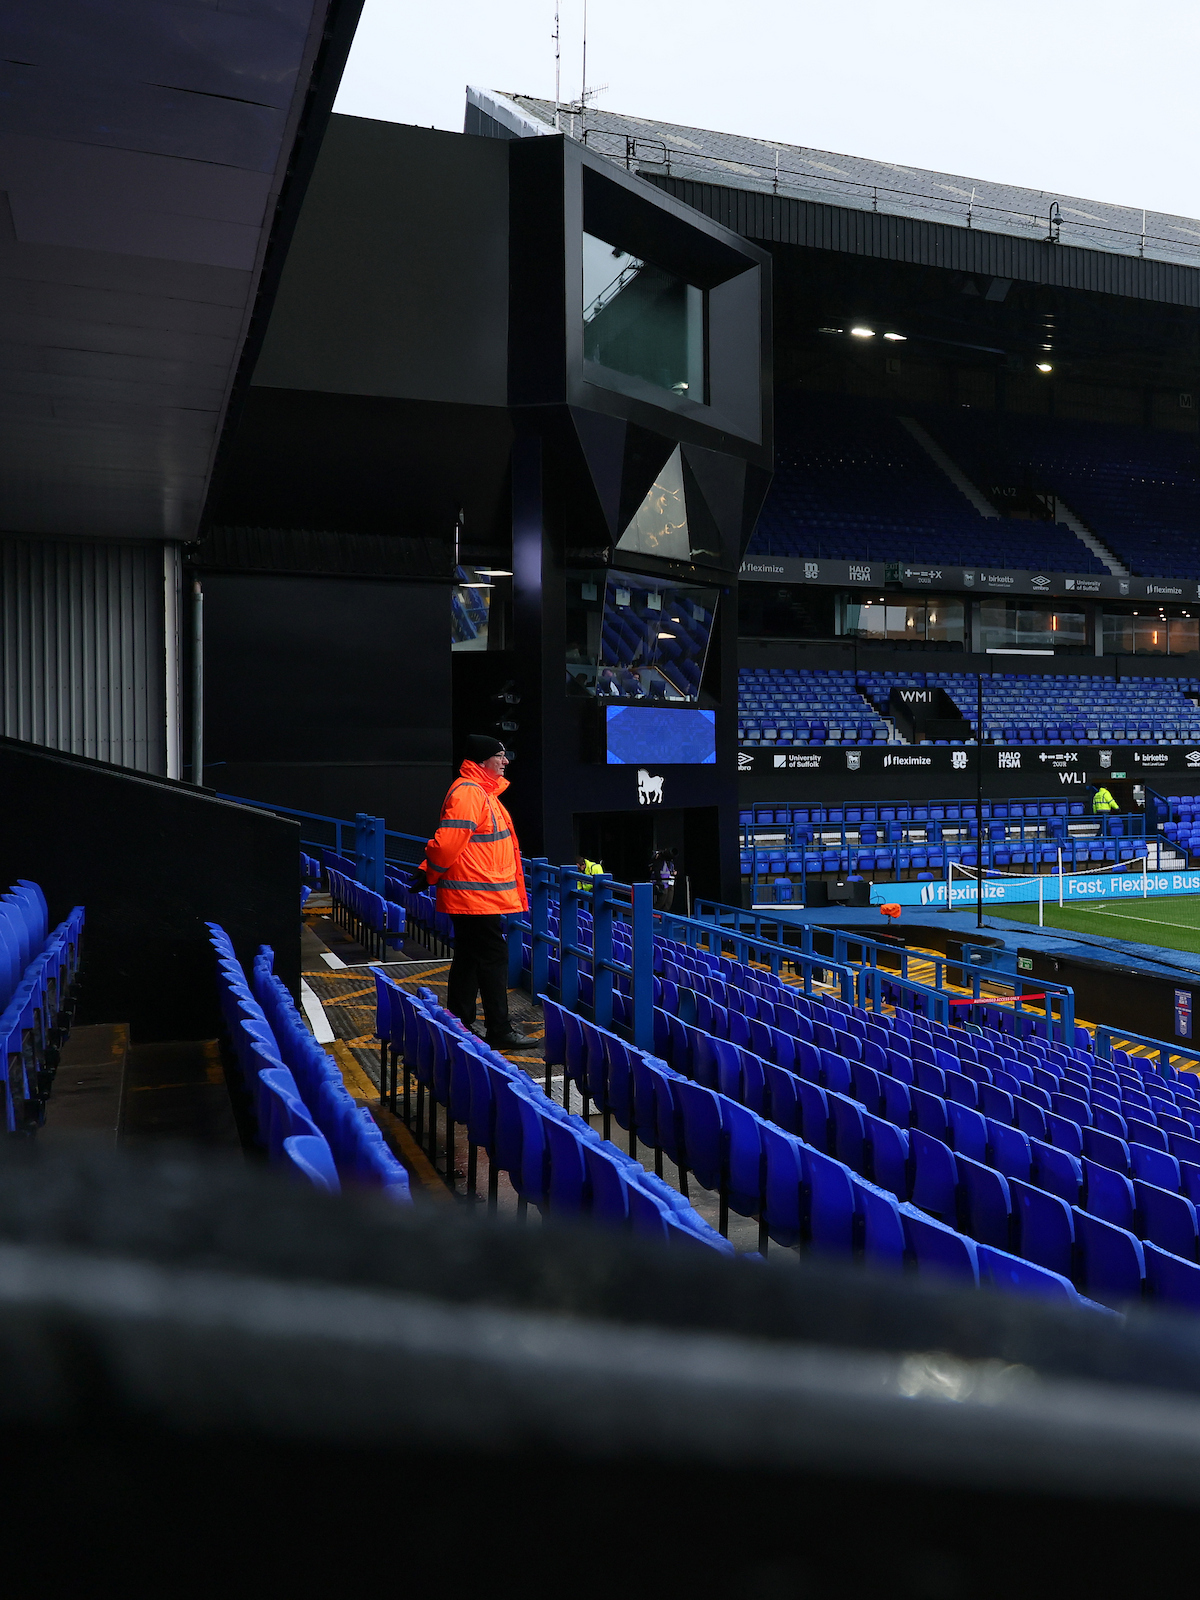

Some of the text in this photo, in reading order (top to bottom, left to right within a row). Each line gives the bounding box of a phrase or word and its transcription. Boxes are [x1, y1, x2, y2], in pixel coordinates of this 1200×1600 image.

[747, 563, 785, 574] fleximize
[849, 565, 871, 574] HALO
[849, 573, 871, 582] ITSM
[988, 575, 1015, 584] birketts
[1076, 580, 1101, 588] University
[1153, 585, 1183, 595] fleximize
[900, 690, 933, 703] WM1
[788, 754, 822, 763] University
[998, 751, 1021, 760] HALO
[1142, 753, 1168, 762] birketts
[893, 756, 932, 765] fleximize
[998, 759, 1021, 769] ITSM
[1058, 772, 1087, 784] WL1
[1068, 879, 1107, 895] Fast,
[1110, 875, 1172, 892] Flexible
